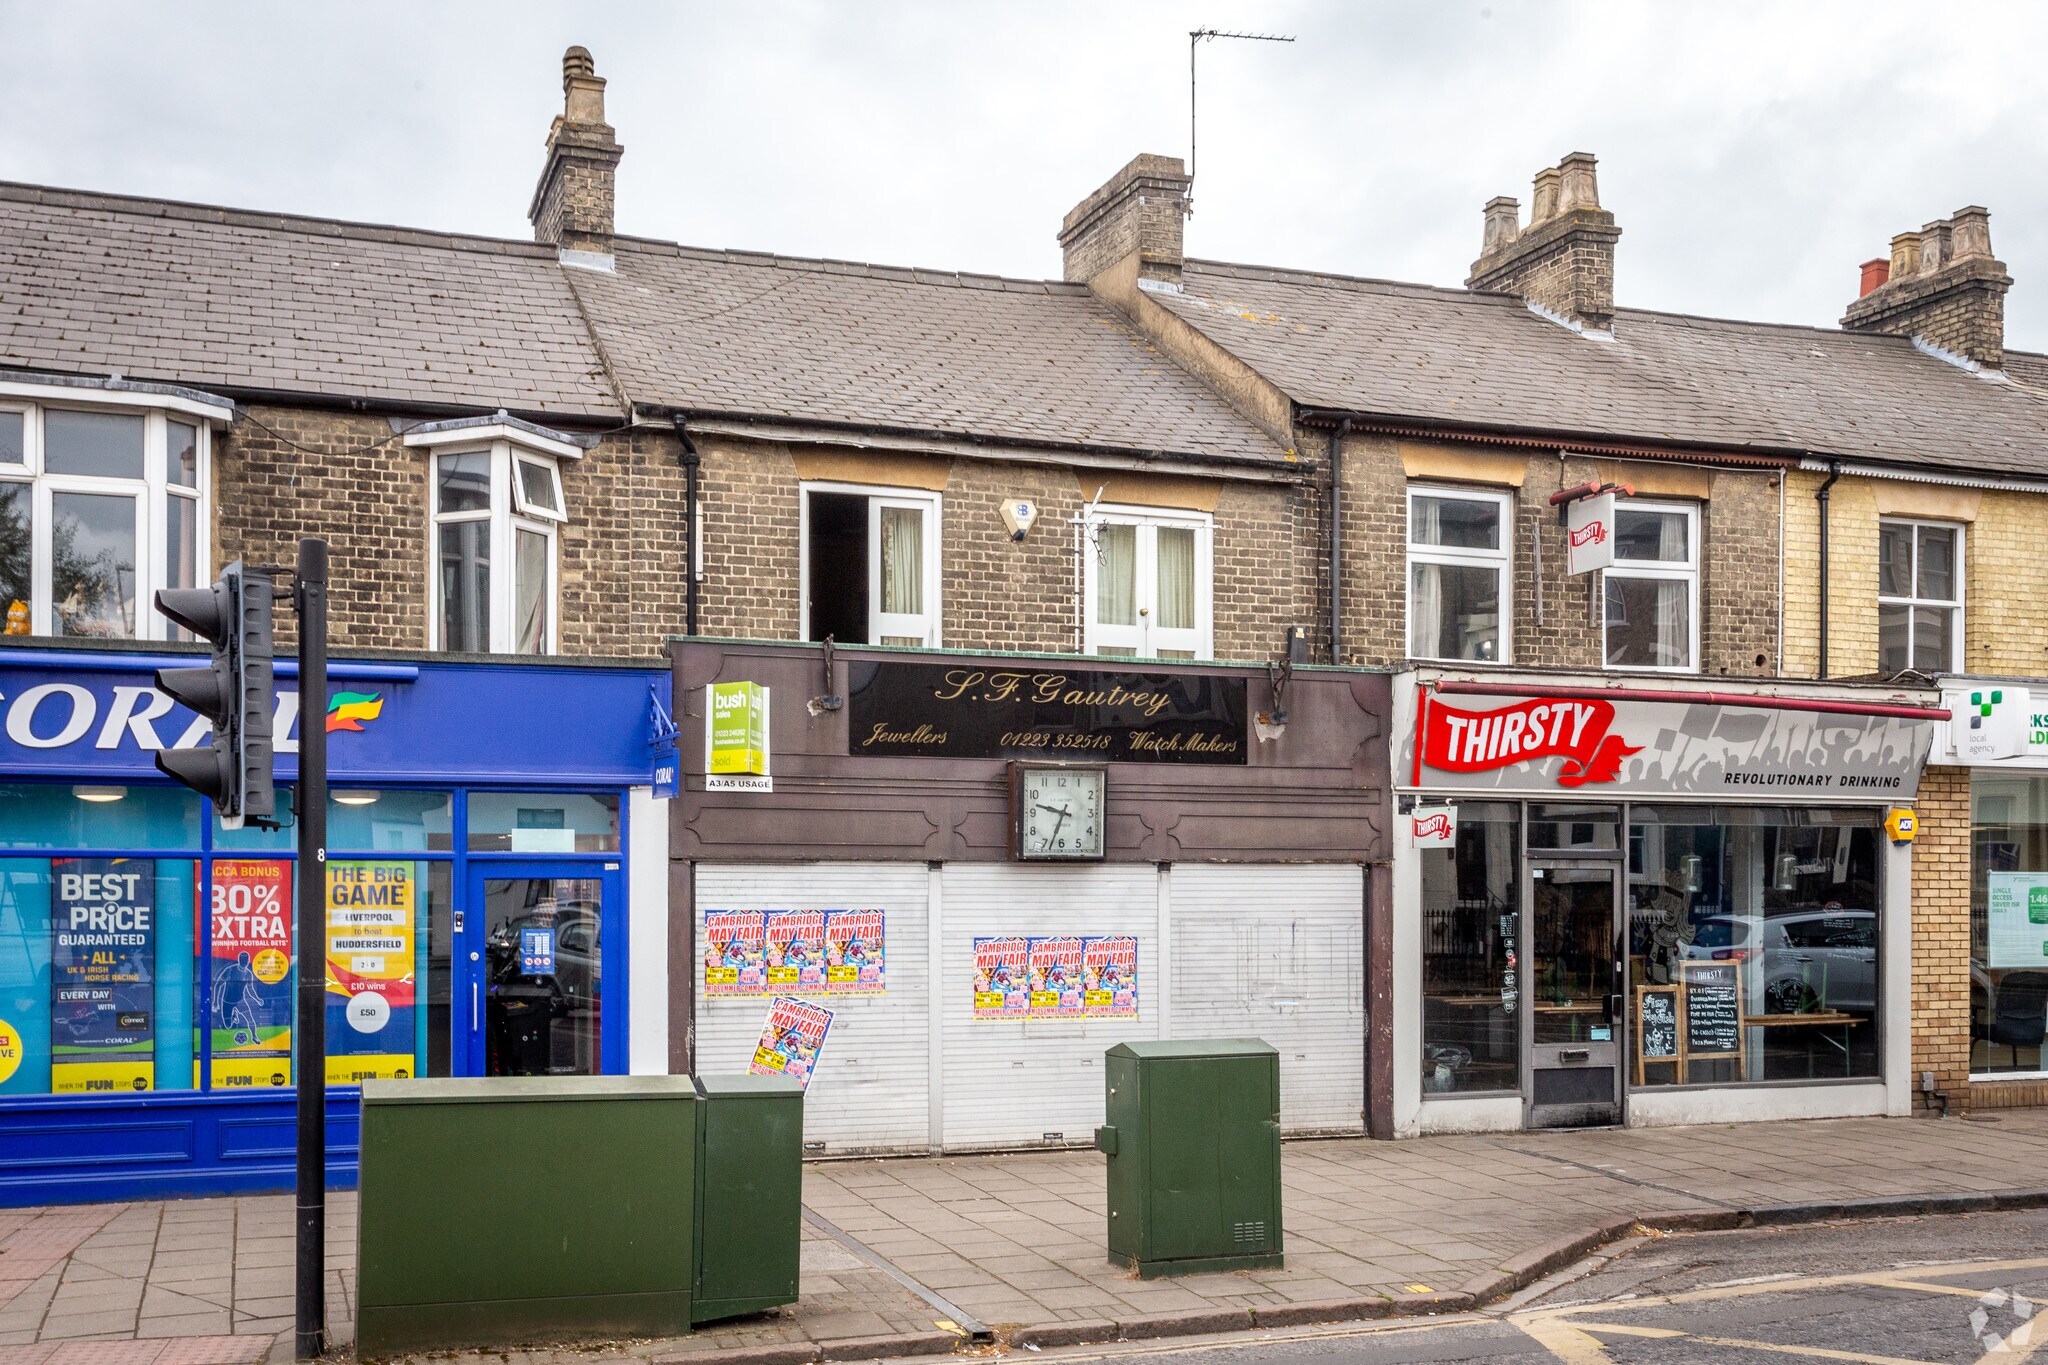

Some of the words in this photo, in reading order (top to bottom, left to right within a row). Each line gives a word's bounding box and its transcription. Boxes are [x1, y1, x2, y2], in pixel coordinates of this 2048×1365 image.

[1574, 523, 1598, 546] THIRSTY
[716, 690, 746, 709] bush
[0, 683, 298, 752] ORL
[862, 722, 948, 747] Jewellers
[1446, 702, 1595, 762] THIRSTY
[1969, 734, 1986, 742] local
[1000, 732, 1050, 749] 01223
[1052, 733, 1112, 750] 352518
[1128, 730, 1178, 752] Watch
[1178, 733, 1238, 754] Makers
[1969, 745, 1995, 754] agency
[714, 756, 731, 766] sold
[656, 767, 672, 784] CORAL
[1724, 772, 1832, 786] REVOLUTIONARY
[1840, 776, 1901, 788] DRINKING
[1041, 777, 1047, 787] 11
[1057, 777, 1066, 787] 12
[1030, 790, 1039, 800] 10
[1088, 790, 1094, 800] 2
[1030, 808, 1036, 818] 9
[1088, 808, 1094, 818] 3
[1030, 826, 1036, 835] 8
[1086, 826, 1093, 835] 4
[1416, 816, 1444, 836] THIRSTY
[1900, 819, 1912, 831] ADT
[1042, 838, 1048, 848] 7
[1059, 839, 1065, 848] 6
[1075, 838, 1081, 848] 5
[317, 848, 325, 862] 8
[241, 867, 280, 876] BONUS
[330, 866, 367, 882] THE
[374, 867, 406, 883] BIG
[61, 874, 140, 901] BEST
[332, 884, 404, 905] GAME
[345, 913, 393, 921] LIVERPOOL
[708, 914, 763, 927] CAMBRIDGE
[769, 914, 824, 927] CAMBRIDGE
[829, 914, 882, 926] CAMBRIDGE
[708, 928, 734, 942] MAY
[737, 926, 763, 940] FAIR
[770, 928, 795, 942] MAY
[797, 926, 824, 939] FAIR
[830, 927, 854, 940] MAY
[856, 925, 882, 939] FAIR
[58, 934, 145, 946] GUARANTEED
[977, 941, 1027, 954] CAMBRIDGE
[1032, 941, 1081, 953] CAMBRIDGE
[1086, 941, 1135, 952] CAMBRIDGE
[92, 951, 117, 964] ALL
[977, 955, 1000, 968] MAY
[1002, 953, 1027, 966] FAIR
[1033, 954, 1055, 967] MAY
[1057, 953, 1081, 966] FAIR
[1087, 954, 1109, 966] MAY
[1112, 952, 1134, 965] FAIR
[1697, 969, 1722, 980] THIRSTY
[706, 985, 740, 993] MIDSUMMER
[741, 984, 764, 992] COMMON
[828, 983, 860, 991] MIDSUMMER
[60, 990, 90, 1000] EVERY
[92, 990, 110, 999] DAY
[774, 1000, 829, 1024] CAMBRIDGE
[770, 1011, 798, 1029] MAY
[797, 1020, 825, 1038] FAIR
[226, 1076, 253, 1086] FUN
[351, 1072, 376, 1081] FUN
[86, 1080, 114, 1090] FUN
